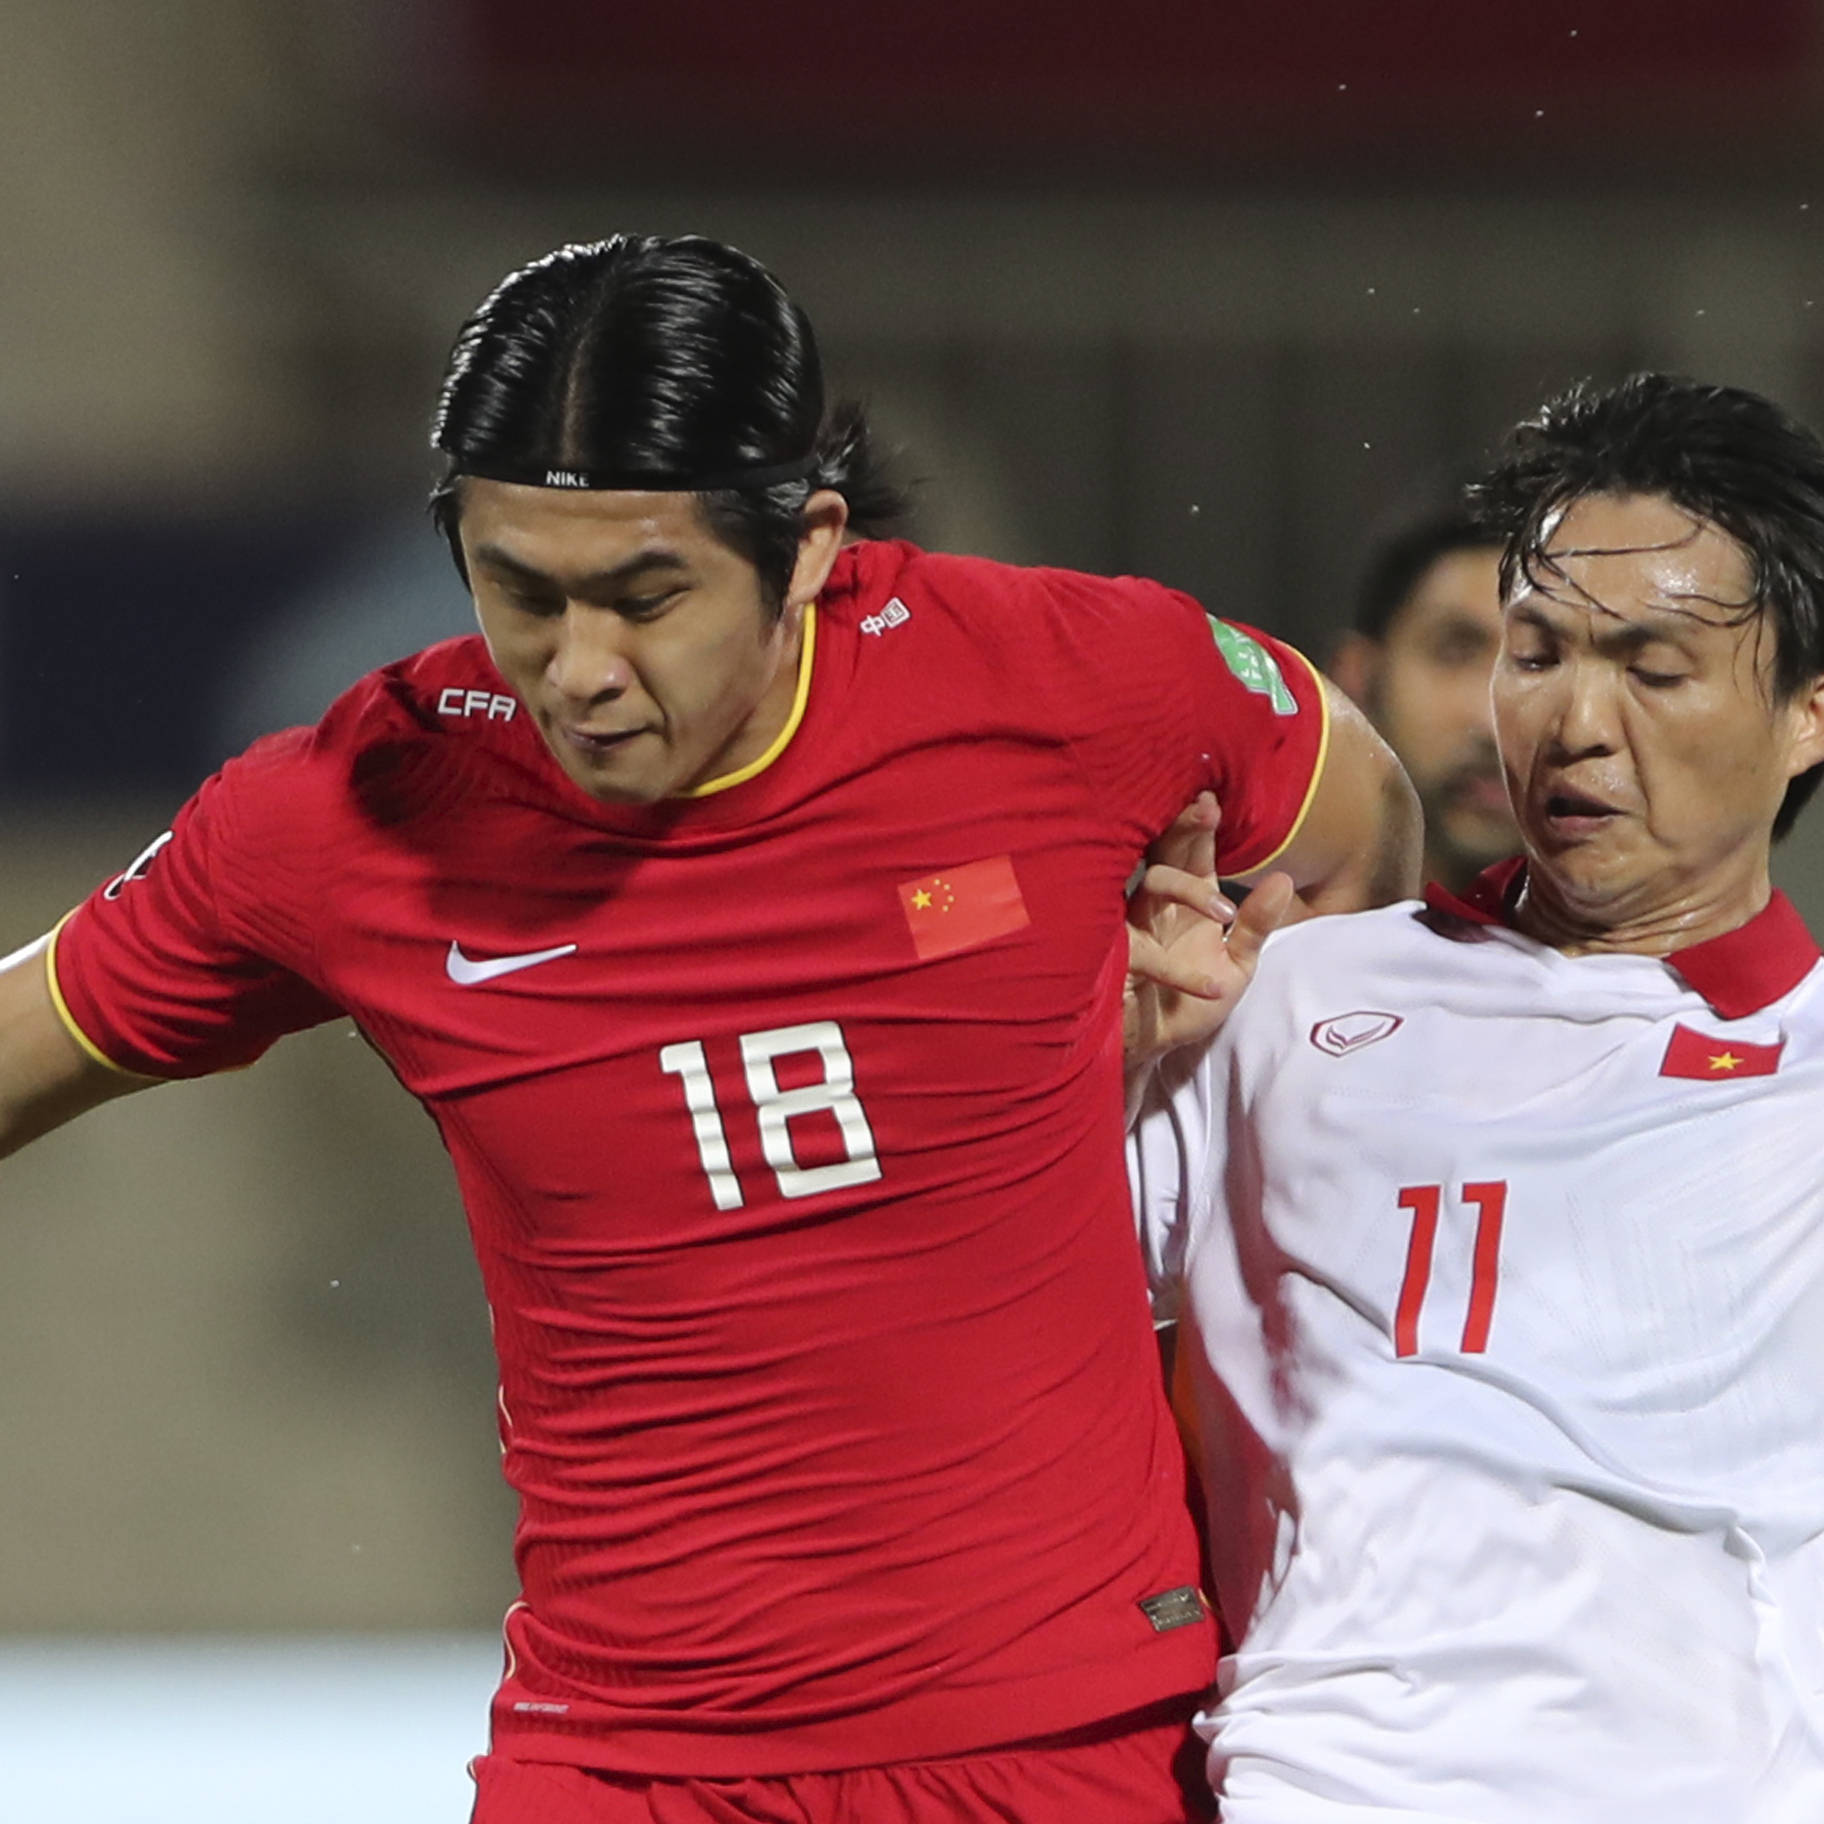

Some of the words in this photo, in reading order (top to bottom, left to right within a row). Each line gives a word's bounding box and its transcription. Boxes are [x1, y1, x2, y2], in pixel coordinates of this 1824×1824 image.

[545, 470, 590, 488] NIKE
[860, 597, 910, 637] 中国
[437, 688, 517, 722] CFA
[659, 1020, 883, 1211] 18
[1394, 1180, 1508, 1359] 11
